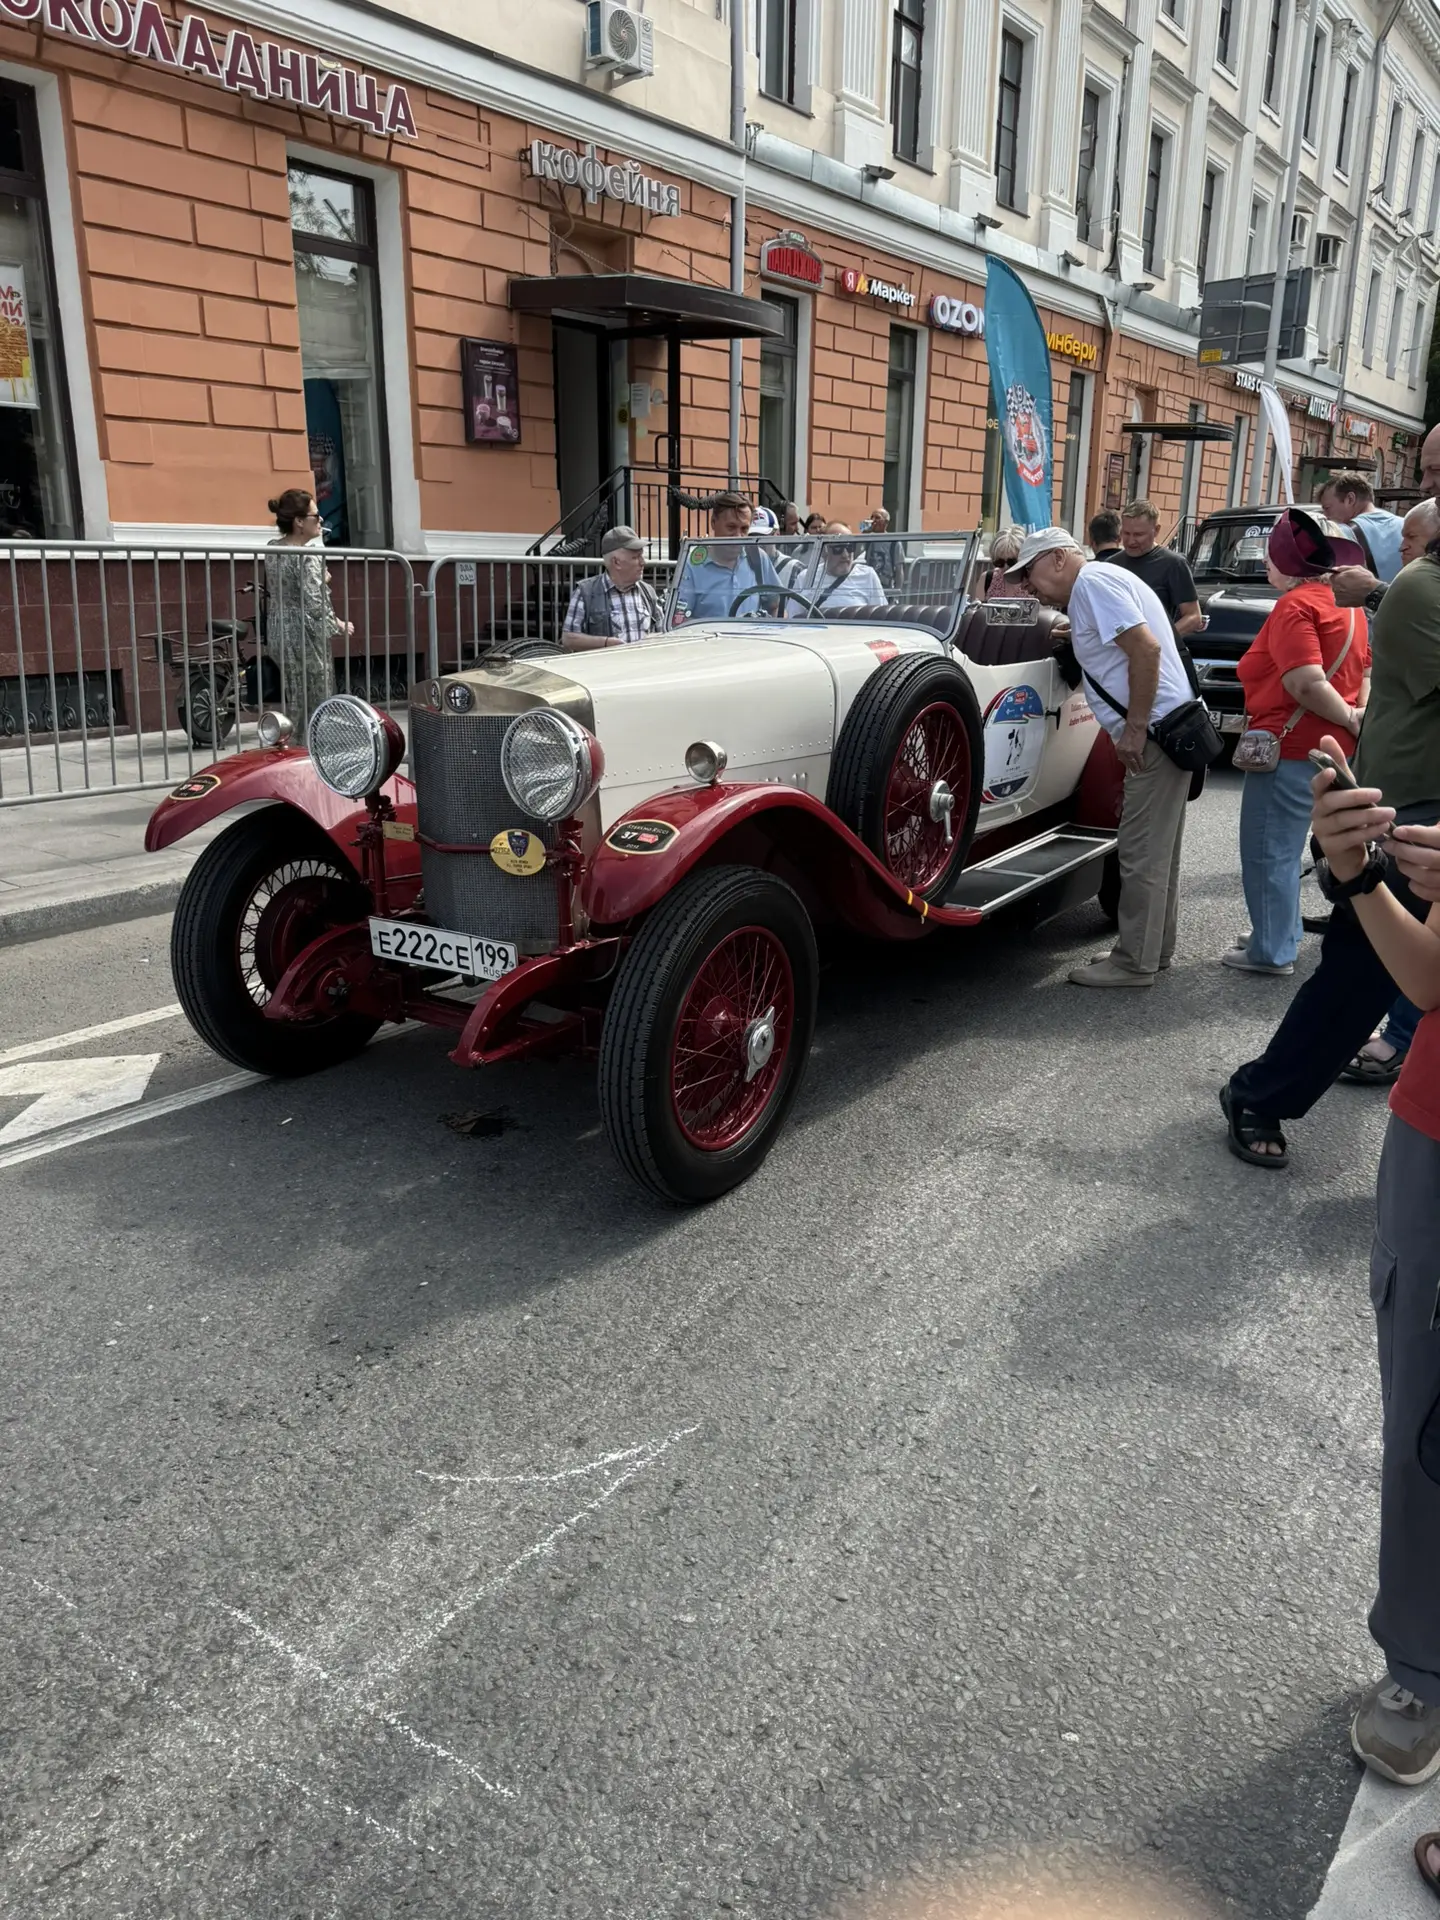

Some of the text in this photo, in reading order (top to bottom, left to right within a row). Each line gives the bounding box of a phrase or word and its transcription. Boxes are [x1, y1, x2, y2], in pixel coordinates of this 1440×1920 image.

[870, 279, 915, 307] Маркет
[620, 831, 638, 840] 37
[378, 928, 509, 970] Е222СЕ 199
[483, 966, 499, 978] RUS
